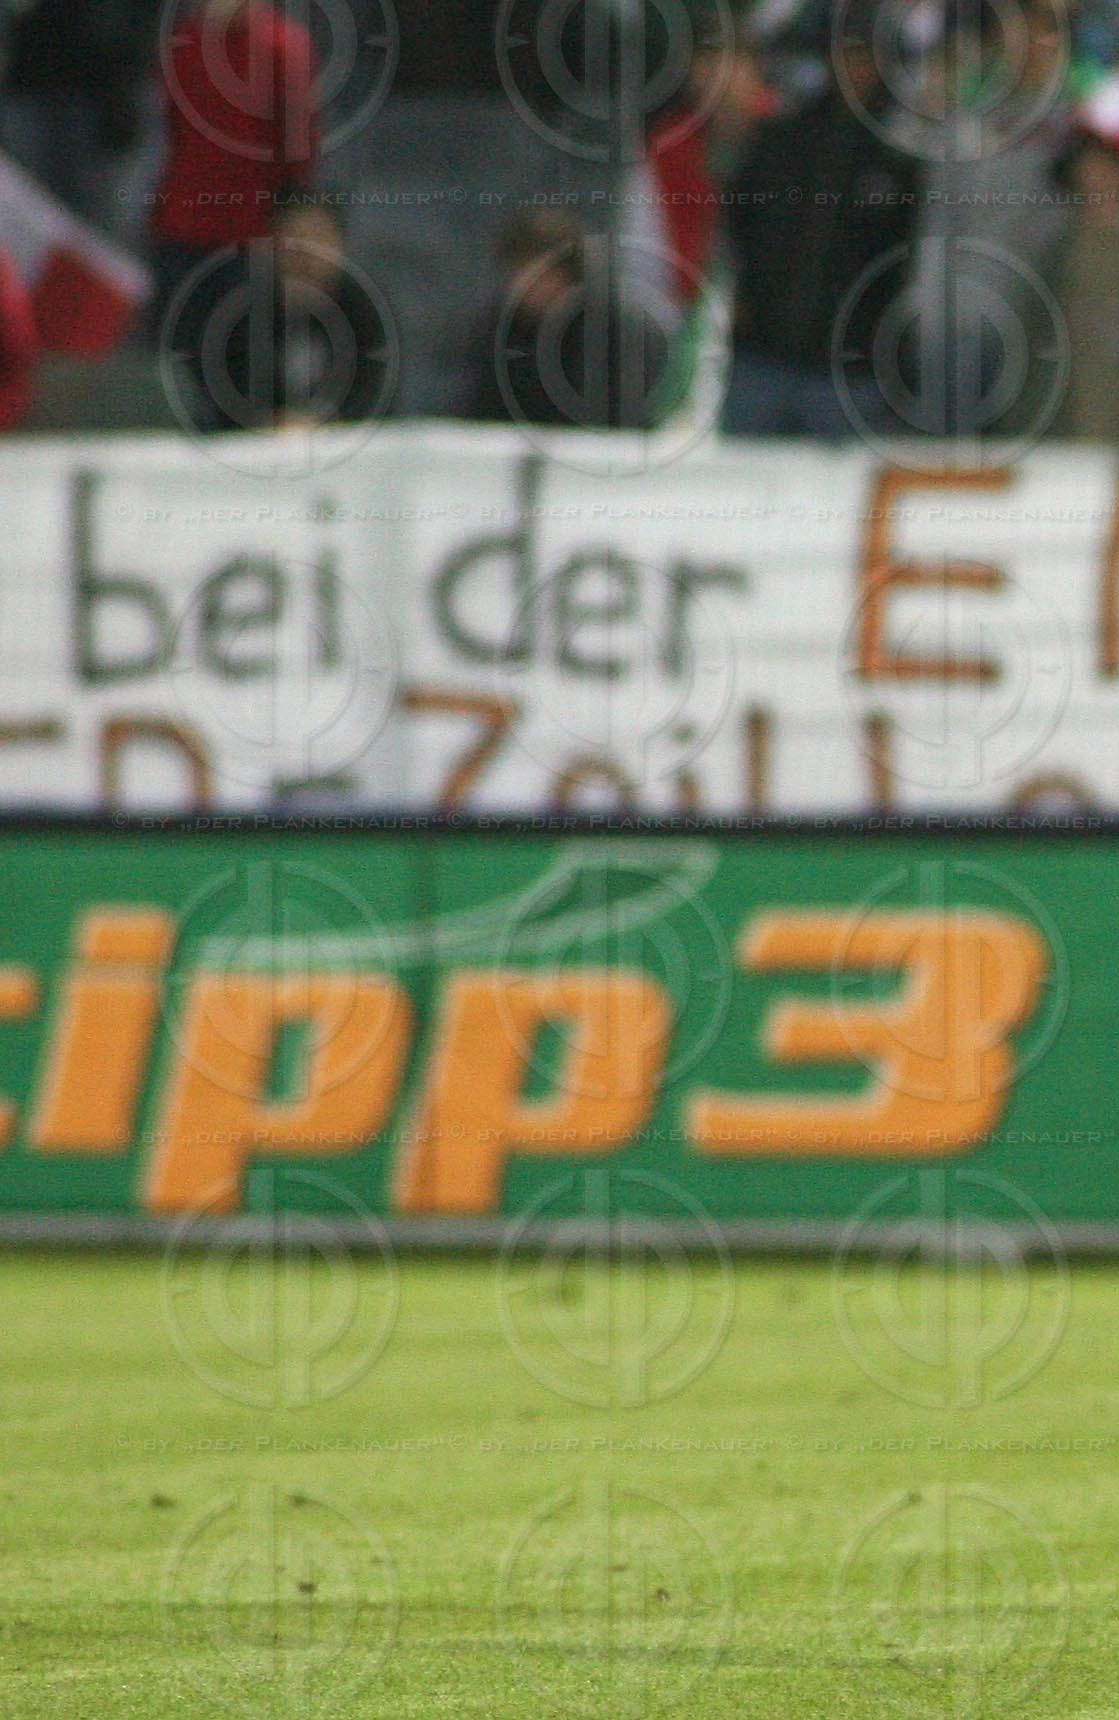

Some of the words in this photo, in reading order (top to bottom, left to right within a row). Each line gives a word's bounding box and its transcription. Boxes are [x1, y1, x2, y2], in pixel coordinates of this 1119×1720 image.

[71, 464, 343, 688] bei
[428, 453, 752, 680] der
[0, 904, 1052, 1216] ipp3
